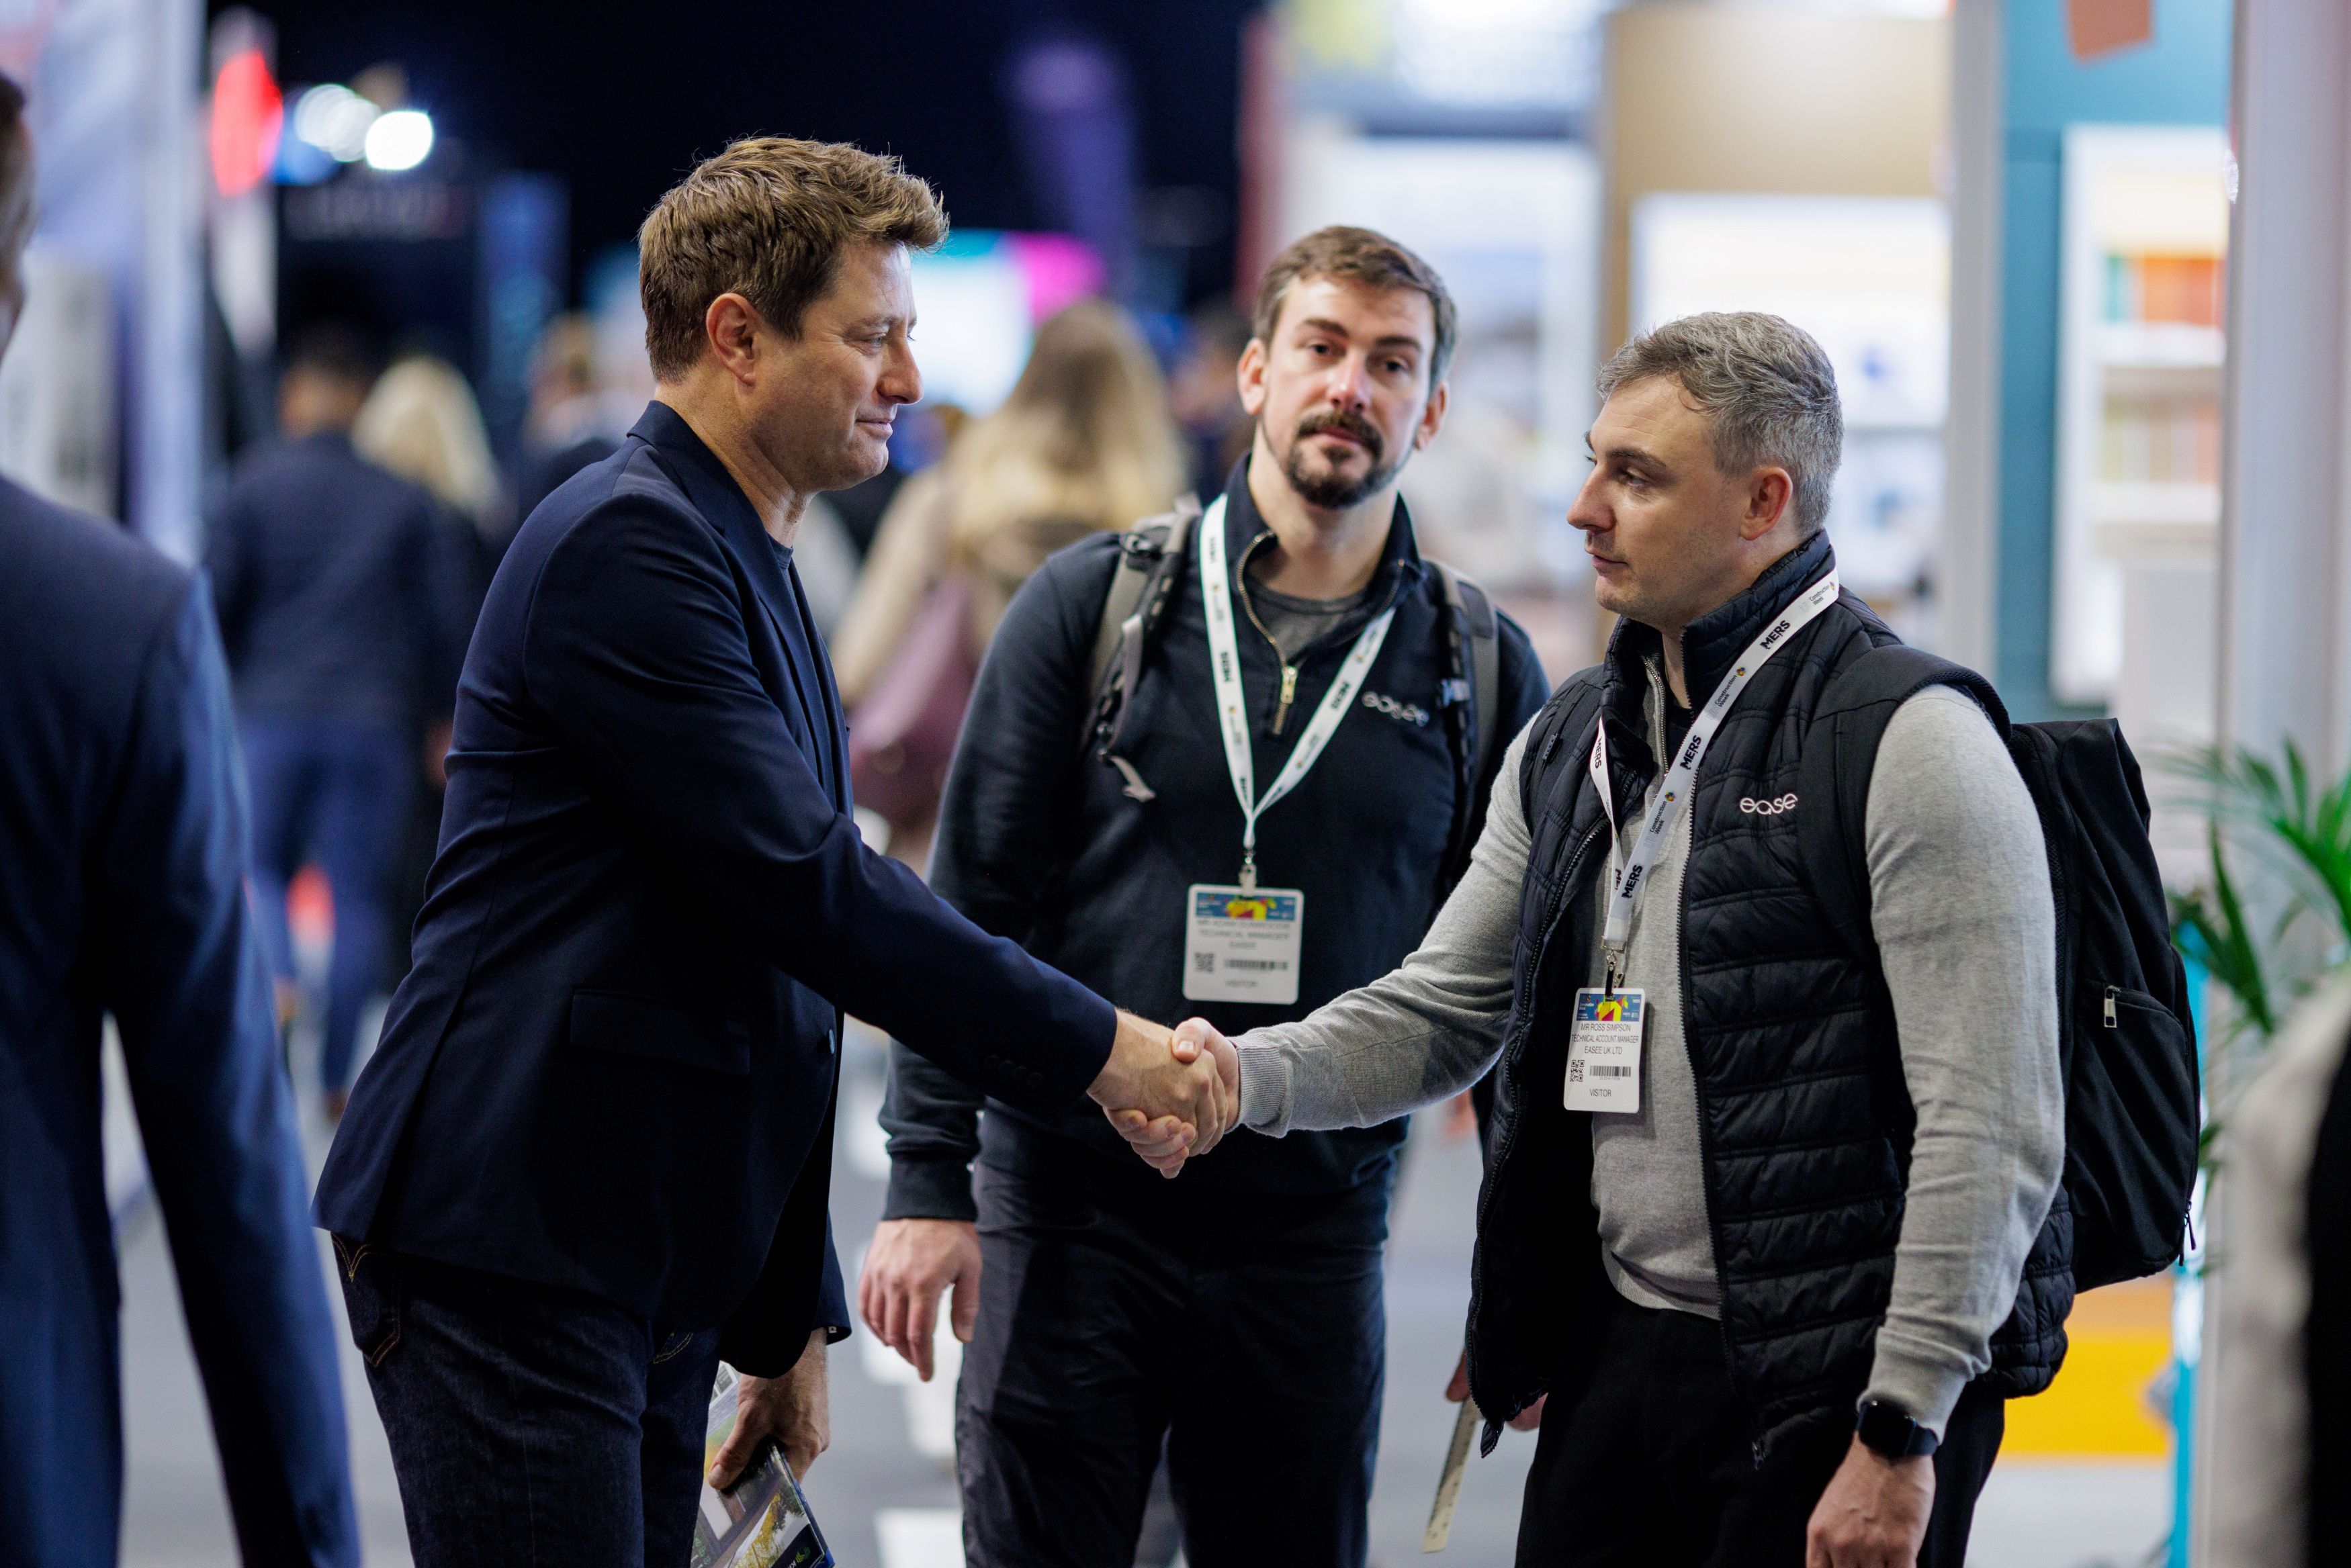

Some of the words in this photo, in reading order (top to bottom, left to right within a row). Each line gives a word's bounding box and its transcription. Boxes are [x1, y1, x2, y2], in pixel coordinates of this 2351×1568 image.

[1760, 620, 1790, 649] MERS
[1715, 675, 1737, 705] Construction
[1718, 693, 1730, 707] Week
[1595, 736, 1603, 770] MERS
[1680, 735, 1702, 770] MERS
[1650, 801, 1667, 833] Construction
[1654, 820, 1665, 835] Week
[1622, 864, 1643, 898] MERS
[1572, 1034, 1595, 1042] TECHNICAL
[1591, 1023, 1605, 1031] ROSS
[1606, 1023, 1631, 1031] SIMPSON
[1585, 1046, 1602, 1054] EASEE
[1603, 1046, 1611, 1054] UK
[1612, 1046, 1623, 1054] LTD
[1589, 1089, 1611, 1097] VISITOR
